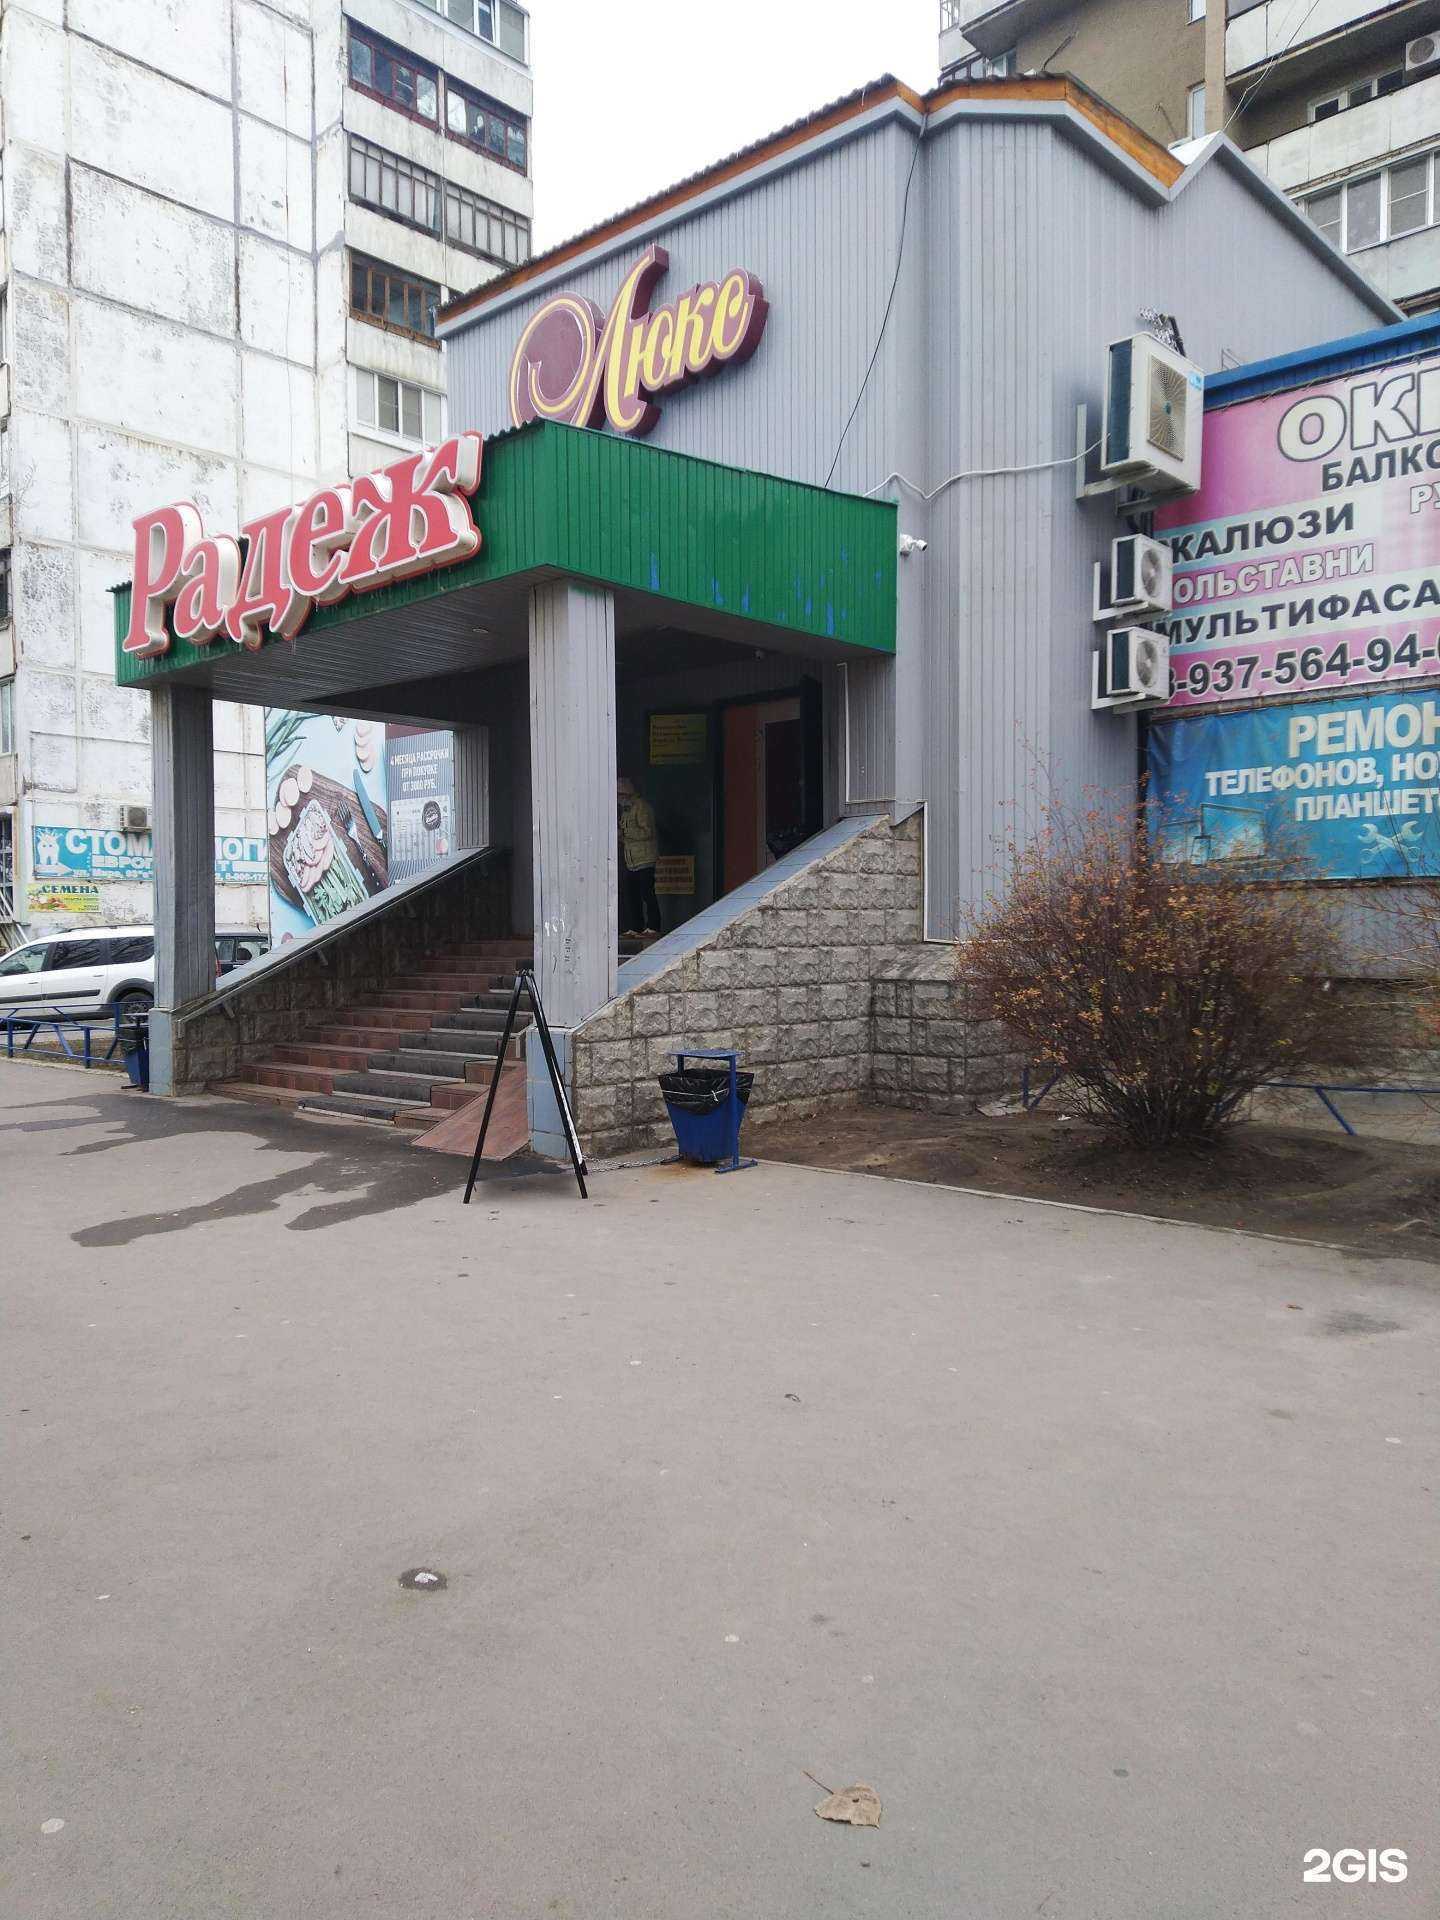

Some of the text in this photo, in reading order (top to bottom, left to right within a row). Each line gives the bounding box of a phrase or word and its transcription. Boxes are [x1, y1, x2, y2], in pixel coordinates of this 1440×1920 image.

[508, 243, 769, 437] Люкс
[122, 430, 484, 658] Радеж
[1173, 543, 1375, 605] ОЛЬСТАВНИ
[1169, 632, 1440, 698] -937-564-94-
[1205, 751, 1440, 797] ТЕЛЕФОНОВ, НО
[1295, 787, 1440, 822] ПЛАНШЕТ
